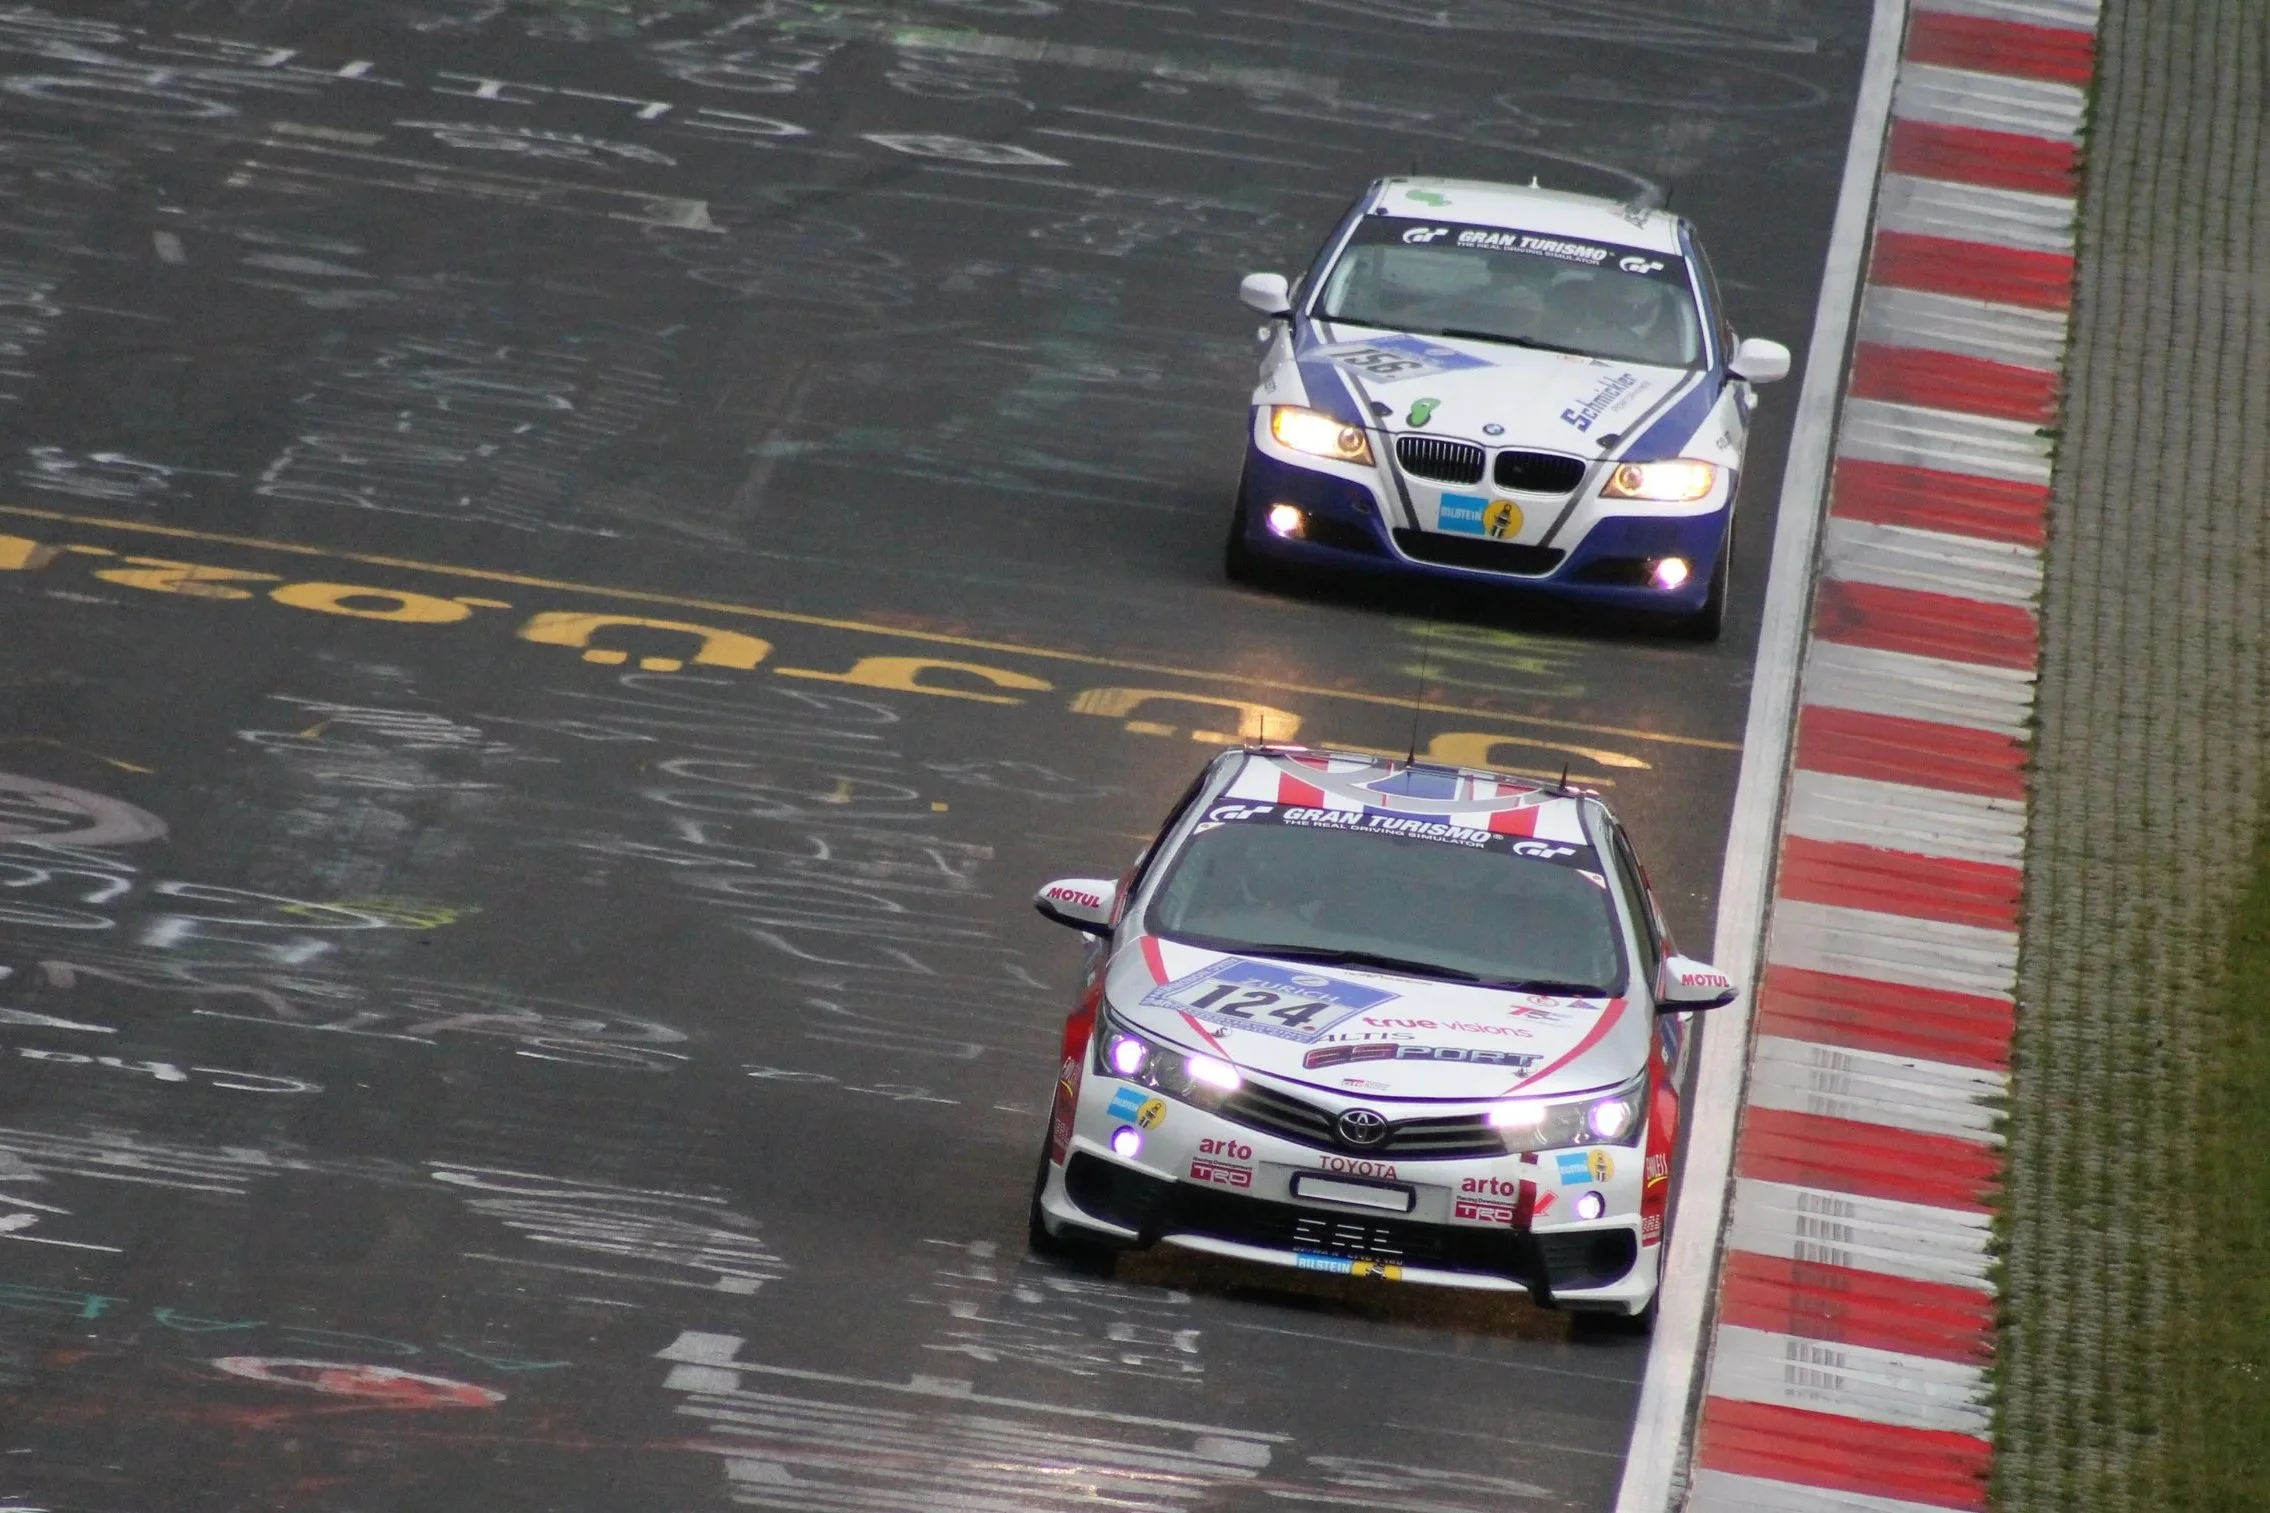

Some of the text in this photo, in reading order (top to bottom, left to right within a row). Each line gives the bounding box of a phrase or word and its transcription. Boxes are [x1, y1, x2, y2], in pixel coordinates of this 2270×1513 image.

[1456, 241, 1601, 266] THE REAL DRIVING SIMULATOR
[1458, 229, 1608, 261] GRAN TURISMO
[1328, 348, 1423, 373] 156
[1560, 372, 1639, 433] Schmickler
[1440, 506, 1482, 520] BILSTEIN
[1283, 807, 1364, 825] GRAN
[1313, 821, 1347, 830] REAL
[1350, 825, 1405, 838] DRIVING
[1408, 832, 1486, 849] SIMULATOR
[1047, 886, 1100, 908] MOTUL
[1681, 974, 1730, 988] MOTUL
[1189, 984, 1330, 1028] 124
[1318, 1031, 1416, 1043] ALTIS
[1362, 1015, 1534, 1039] true visions
[1200, 1137, 1252, 1160] arto
[1192, 1163, 1252, 1187] TRD
[1320, 1155, 1398, 1180] TOYOTA
[1461, 1176, 1515, 1197] arto
[1456, 1202, 1515, 1223] TRD
[1297, 1258, 1353, 1275] BILSTEIN
